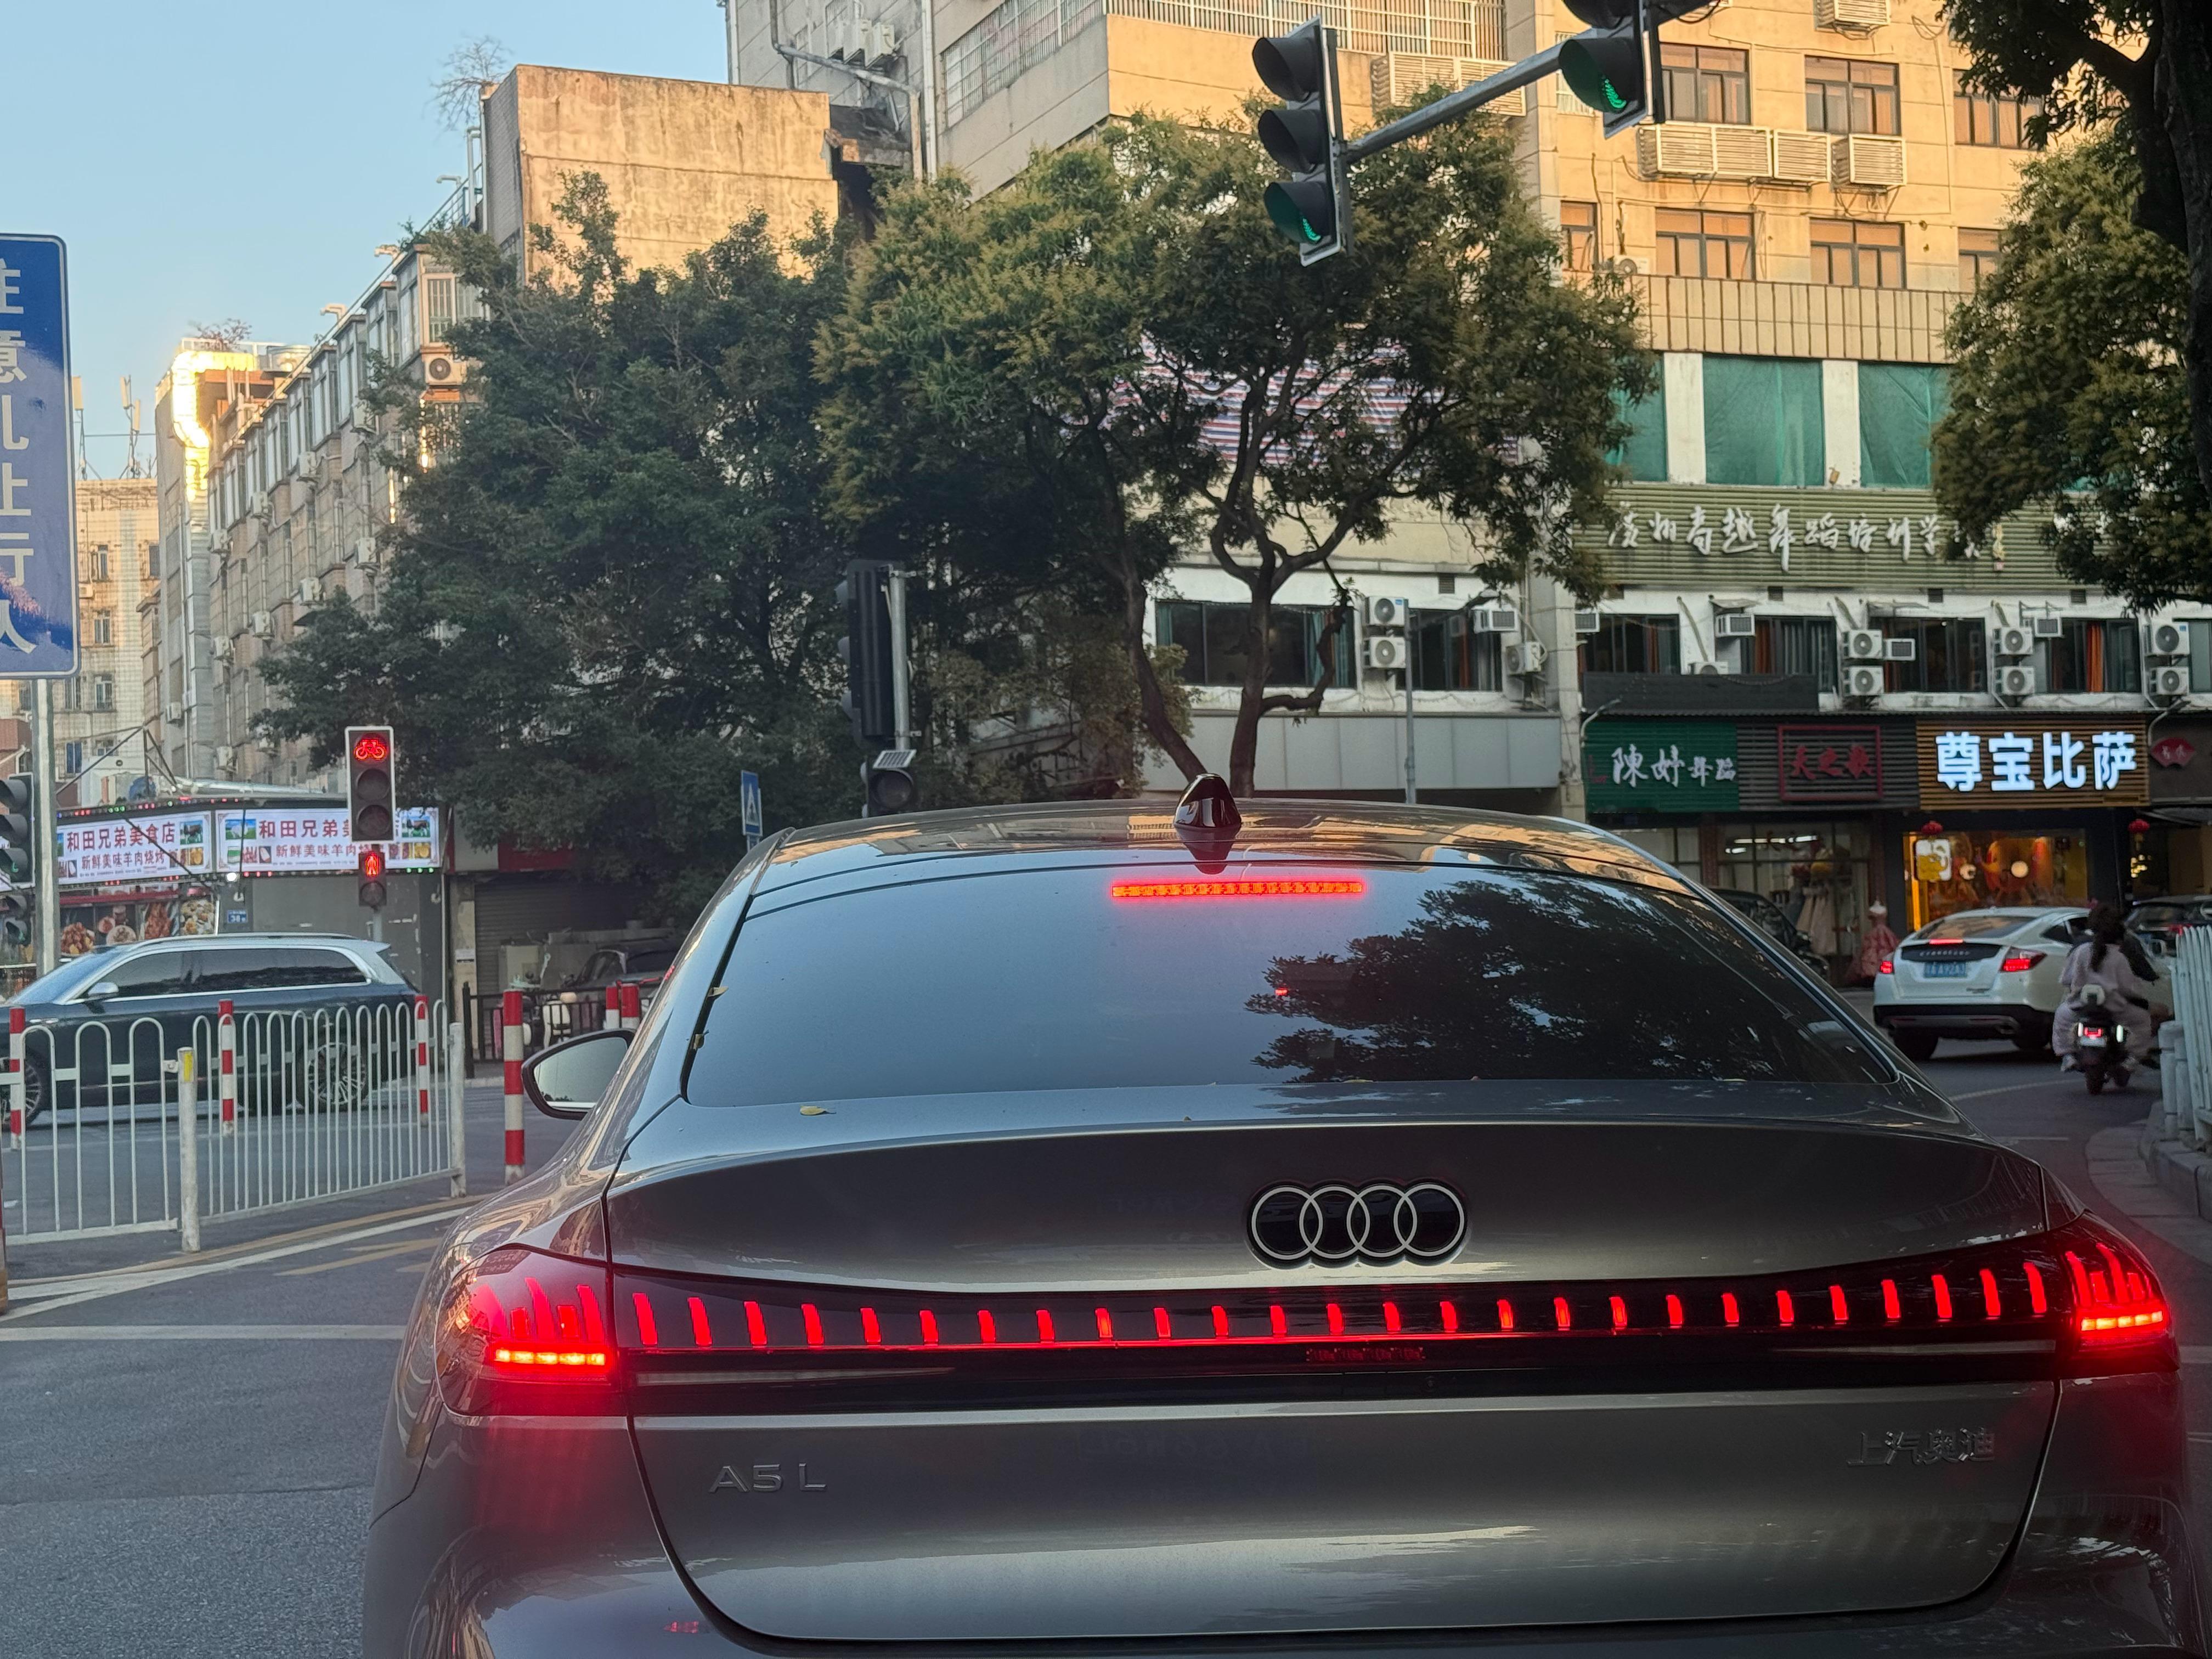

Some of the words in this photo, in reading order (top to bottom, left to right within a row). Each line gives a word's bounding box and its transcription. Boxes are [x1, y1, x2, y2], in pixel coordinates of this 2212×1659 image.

[1935, 731, 2137, 792] 尊宝比萨
[66, 822, 176, 853] 和田兄弟美食店
[258, 819, 399, 839] 和田兄弟
[81, 849, 165, 870] 新鲜美味羊肉烧烤
[275, 843, 385, 858] 新鲜美味羊肉
[1846, 1426, 1995, 1466] 上汽奥迪
[709, 1463, 783, 1493] A5
[799, 1462, 828, 1492] L
